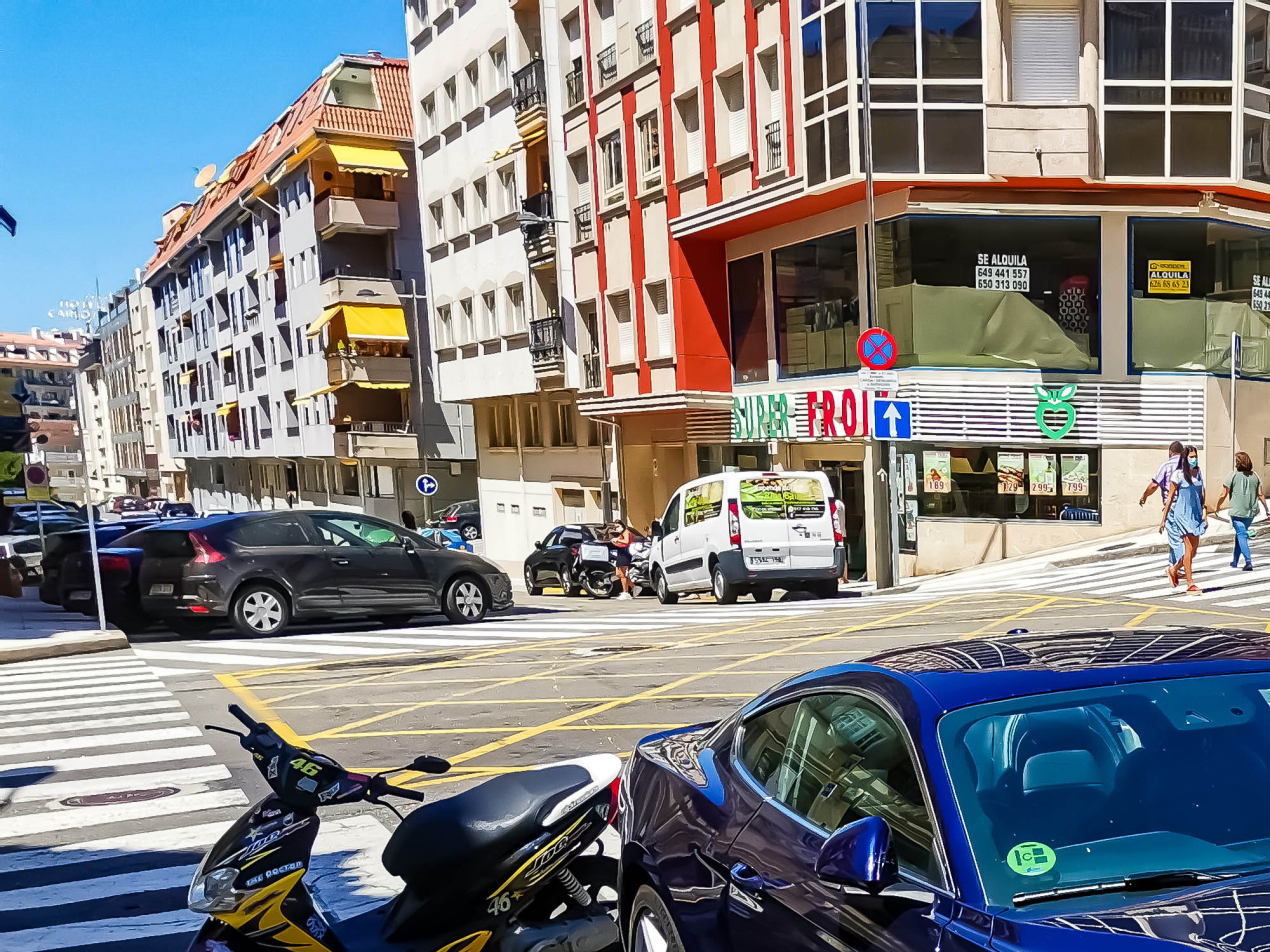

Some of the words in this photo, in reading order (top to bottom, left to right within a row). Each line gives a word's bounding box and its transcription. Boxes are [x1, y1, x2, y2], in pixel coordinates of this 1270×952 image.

[978, 254, 989, 265] SE
[991, 254, 1028, 266] ALQUILA
[978, 268, 993, 277] 649
[995, 269, 1010, 278] 441
[1012, 269, 1028, 279] 557
[1151, 271, 1189, 279] ALQUILA
[978, 279, 993, 289] 650
[995, 280, 1010, 289] 313
[1253, 274, 1261, 286] SE
[734, 393, 790, 439] SUPER
[808, 389, 878, 438] FROI
[290, 758, 322, 776] 46
[487, 892, 511, 915] 46
